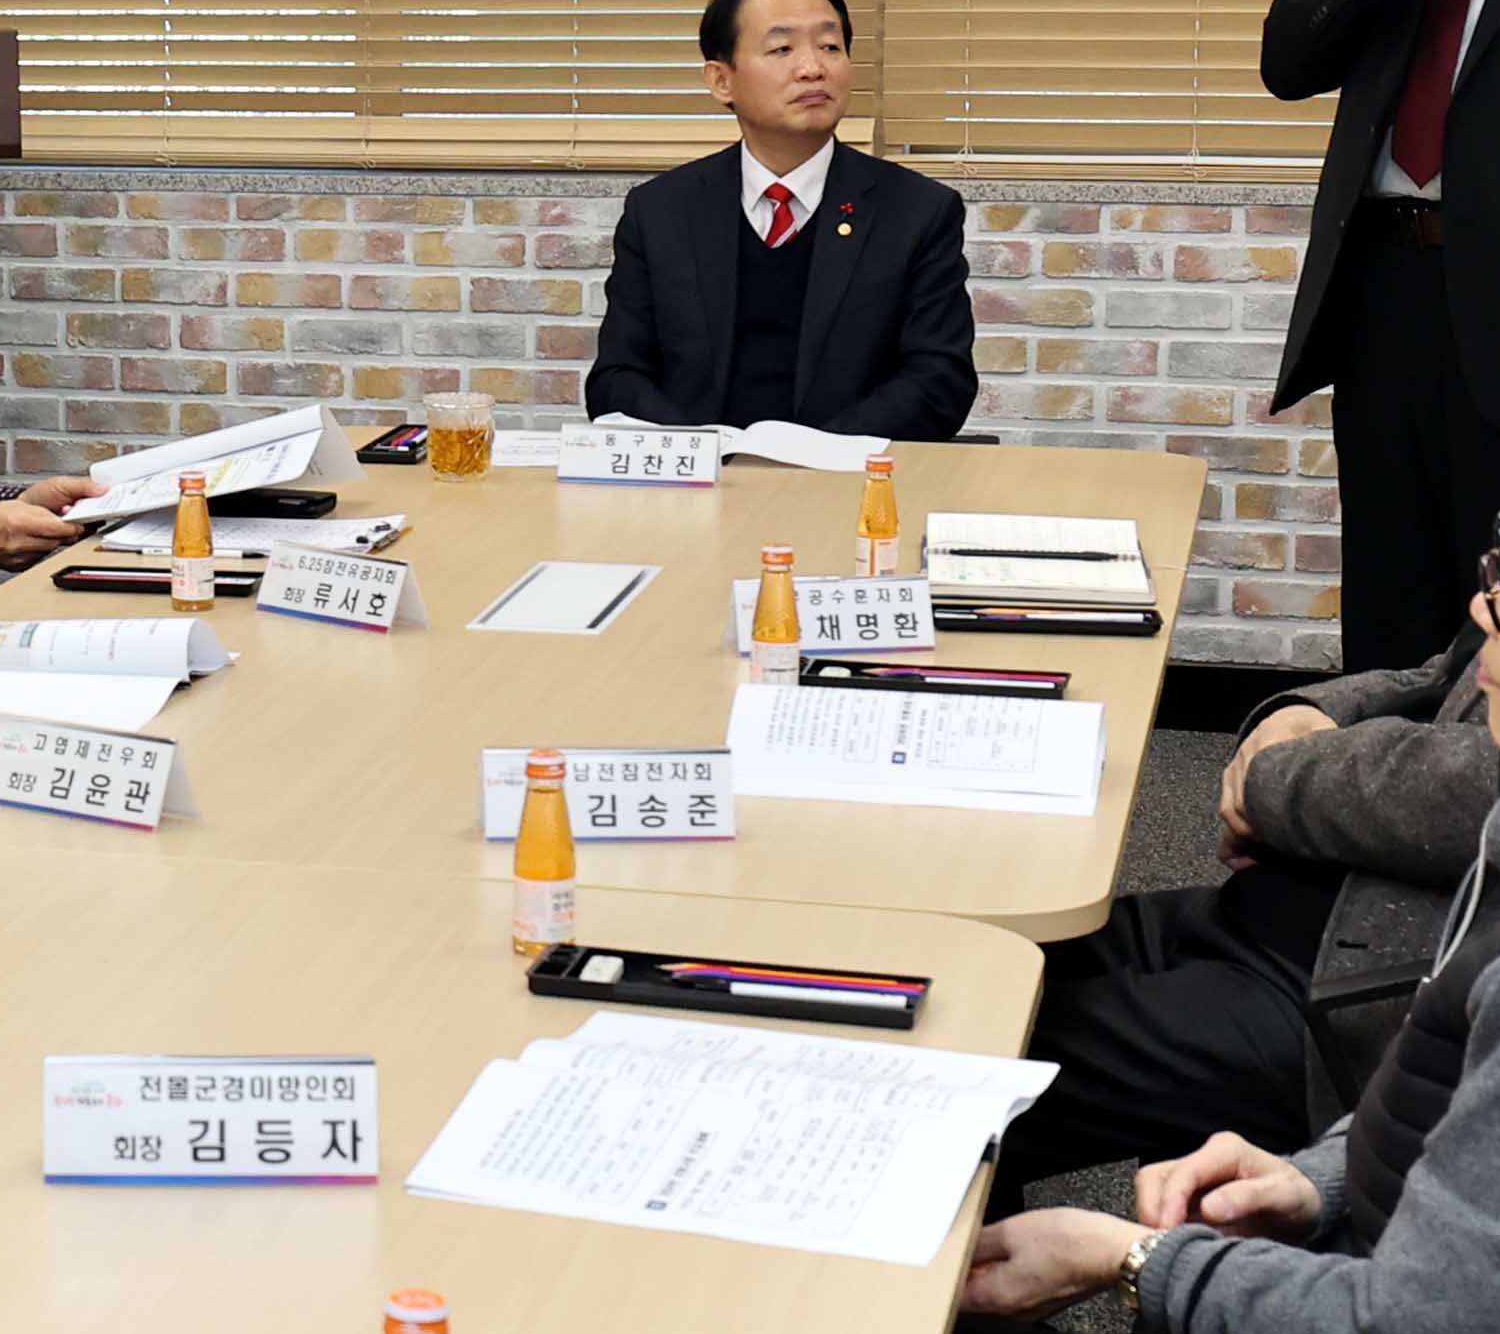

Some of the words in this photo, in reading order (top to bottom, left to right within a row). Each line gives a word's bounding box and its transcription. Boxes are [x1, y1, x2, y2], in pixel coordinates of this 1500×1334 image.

[282, 587, 305, 603] 회장
[794, 588, 913, 605] 공수훈자회
[7, 771, 37, 793] 회장
[573, 762, 713, 783] 남전참전자회
[113, 1135, 162, 1162] 회장
